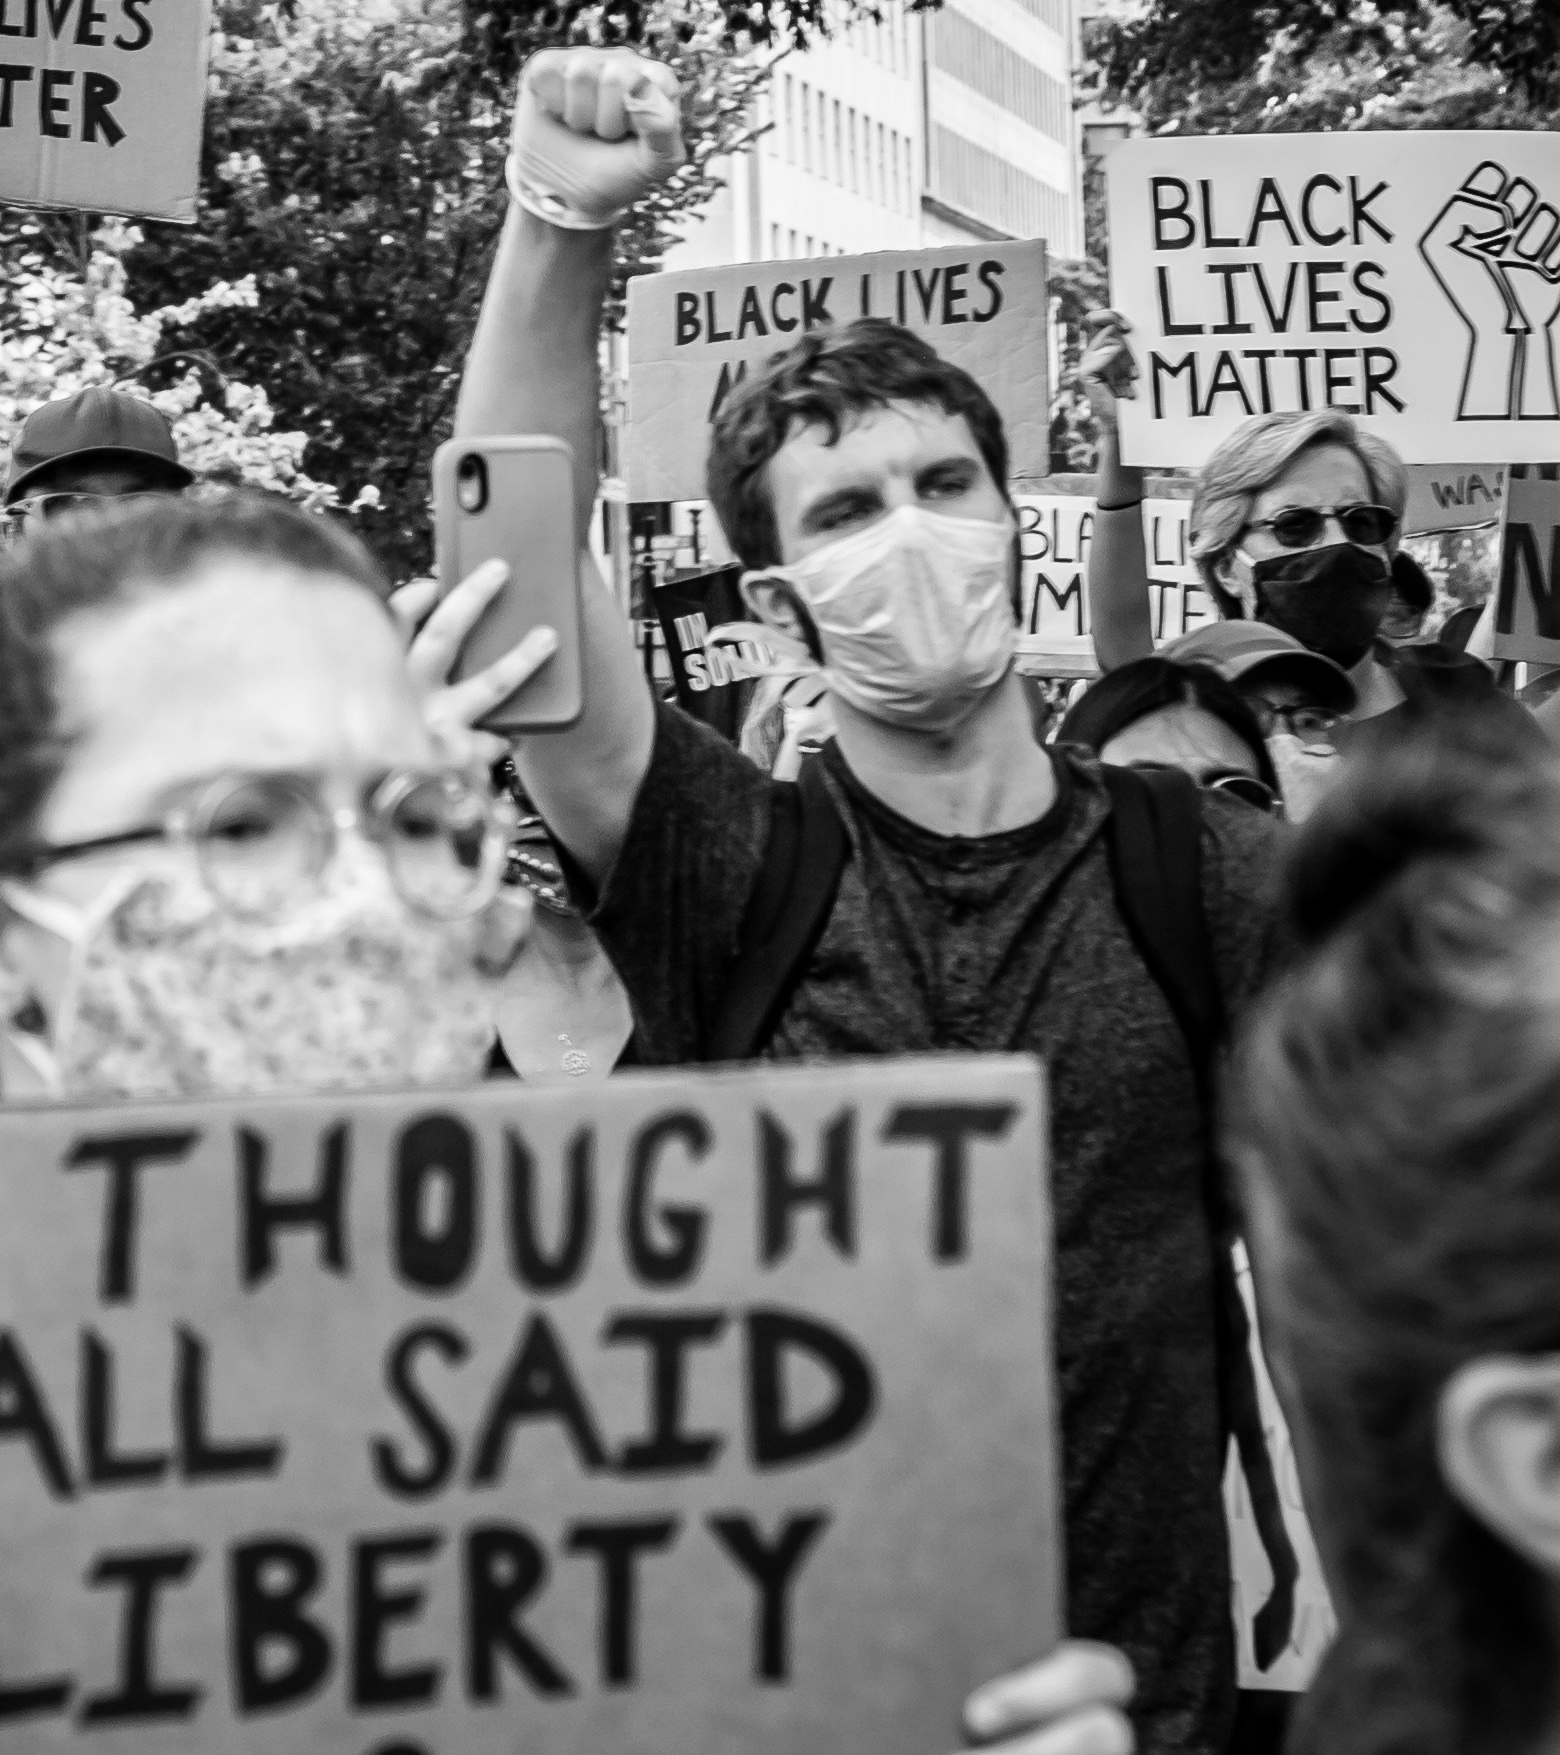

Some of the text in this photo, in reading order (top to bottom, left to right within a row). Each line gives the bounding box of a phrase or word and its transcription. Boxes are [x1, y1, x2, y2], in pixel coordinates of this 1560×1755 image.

[1149, 174, 1396, 250] BLACK
[674, 260, 1007, 346] BLACK LIVES
[1155, 261, 1395, 336] LIVES
[1149, 347, 1410, 419] MATTER
[64, 1102, 1023, 1305] THOUGHT
[370, 1305, 878, 1503] SAID
